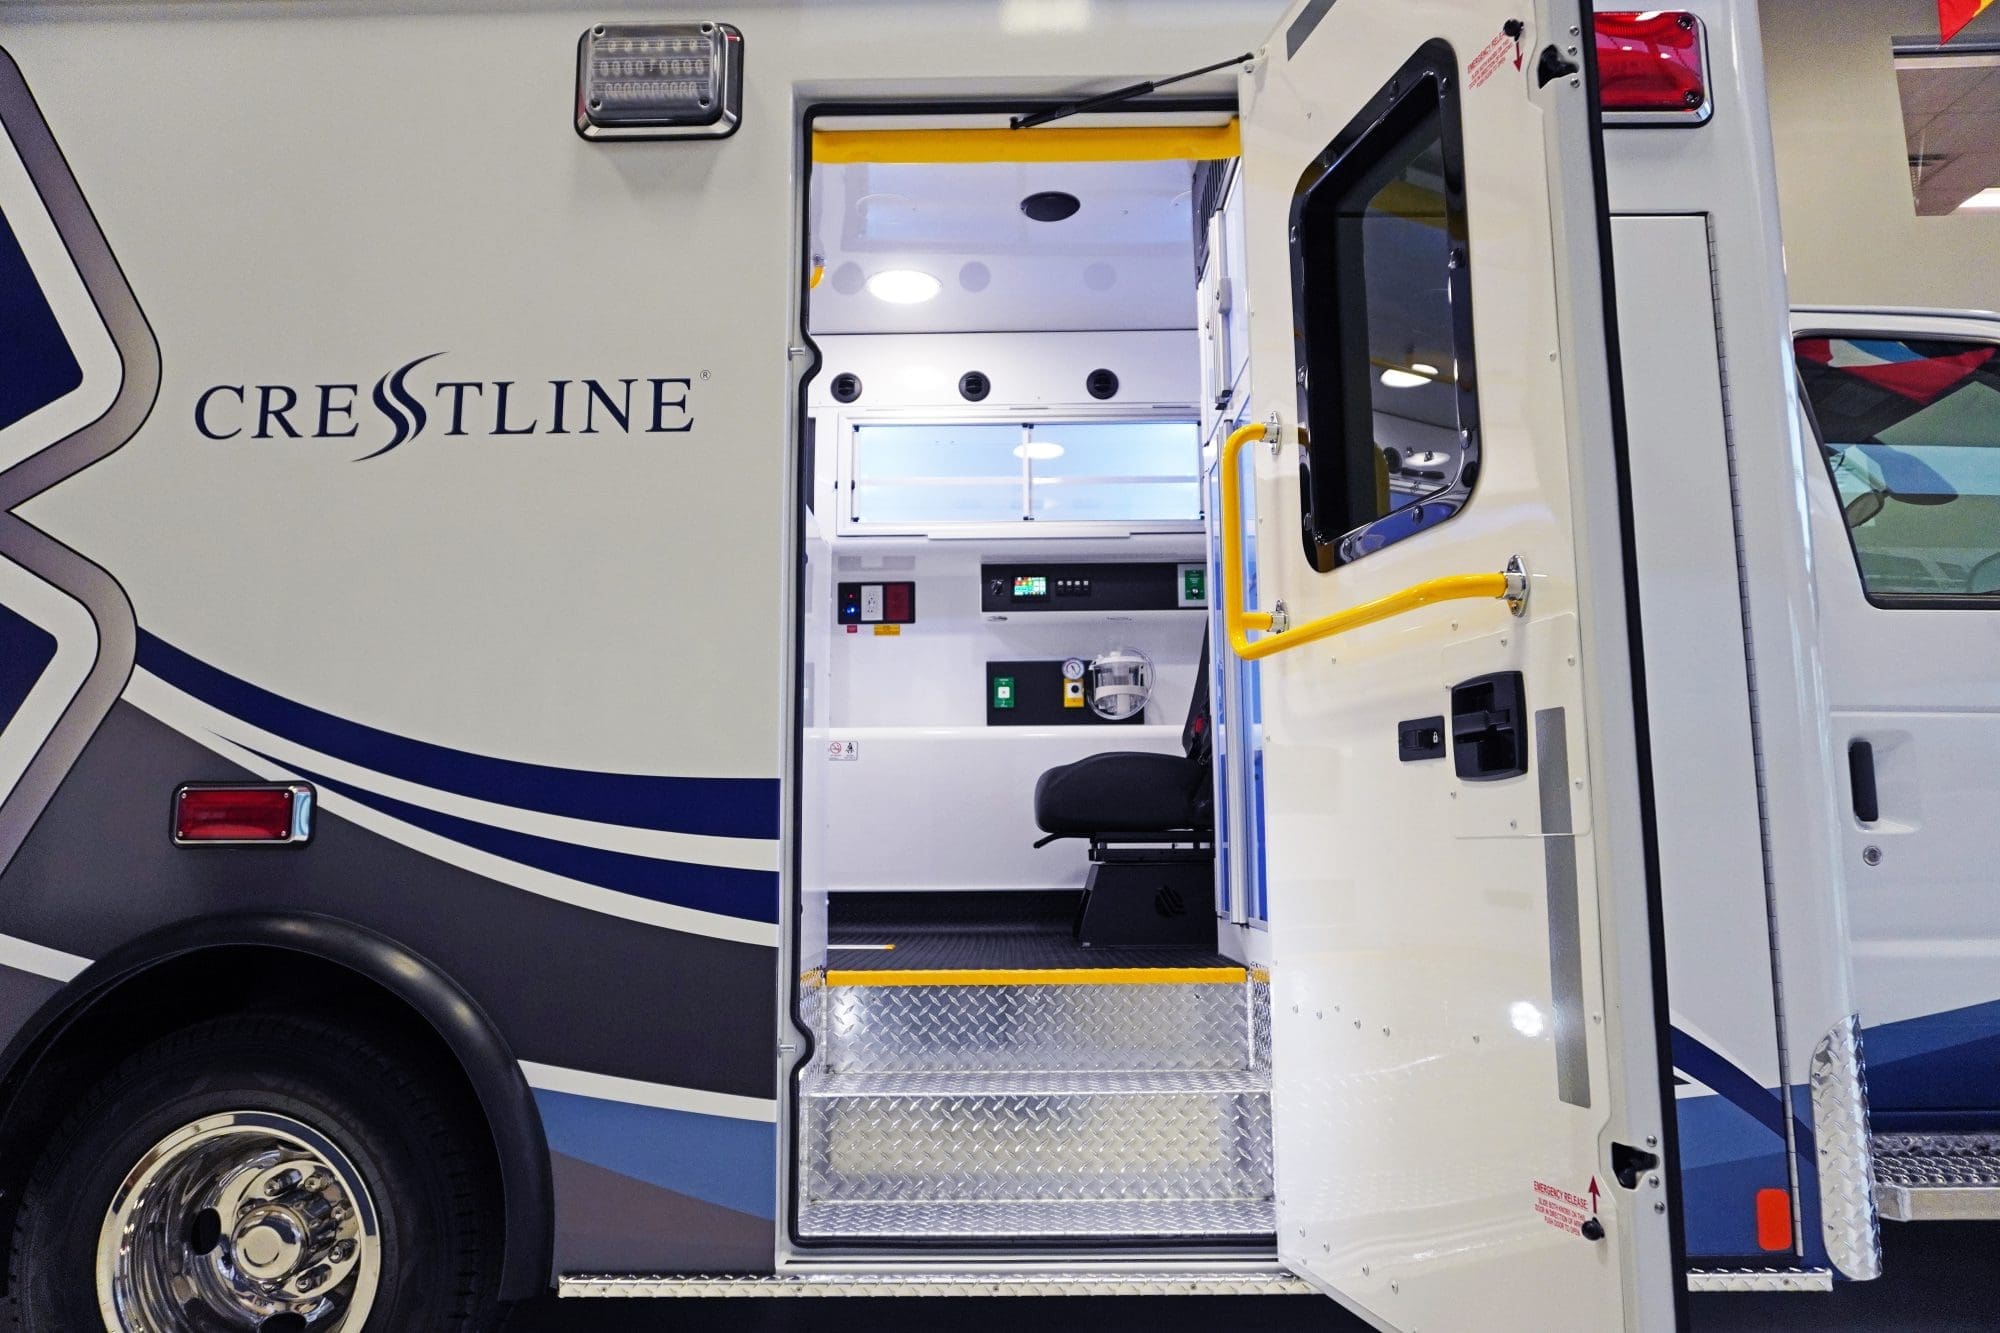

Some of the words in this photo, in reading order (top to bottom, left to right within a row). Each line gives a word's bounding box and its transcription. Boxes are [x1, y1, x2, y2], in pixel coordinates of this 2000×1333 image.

[195, 351, 695, 462] CRESTLINE
[1534, 1180, 1563, 1200] EMERGENCY
[1563, 1192, 1588, 1210] RELEASE
